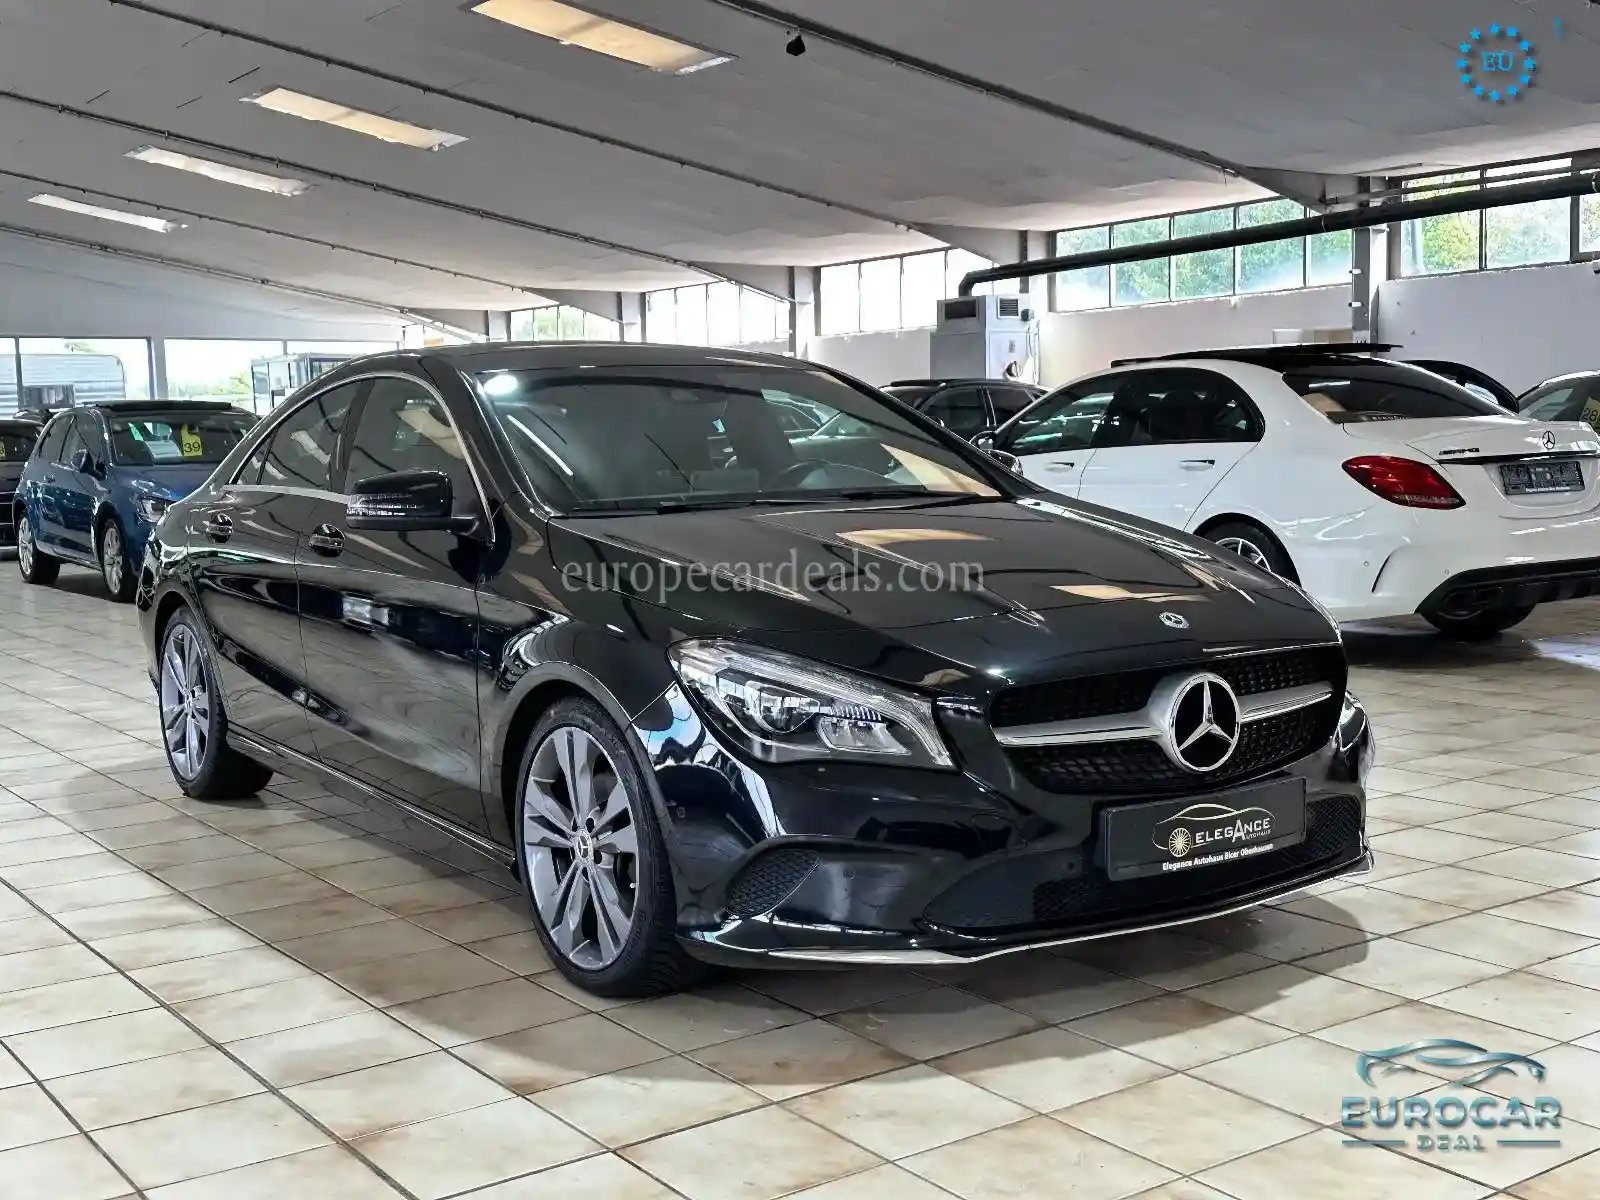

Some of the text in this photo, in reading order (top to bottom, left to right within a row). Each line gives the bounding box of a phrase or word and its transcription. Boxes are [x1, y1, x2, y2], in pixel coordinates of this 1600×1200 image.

[1582, 408, 1600, 422] 28
[184, 442, 201, 452] 39
[1195, 818, 1271, 843] ELEGANCE
[1162, 859, 1193, 872] Elegance
[1193, 854, 1223, 866] Autohaus
